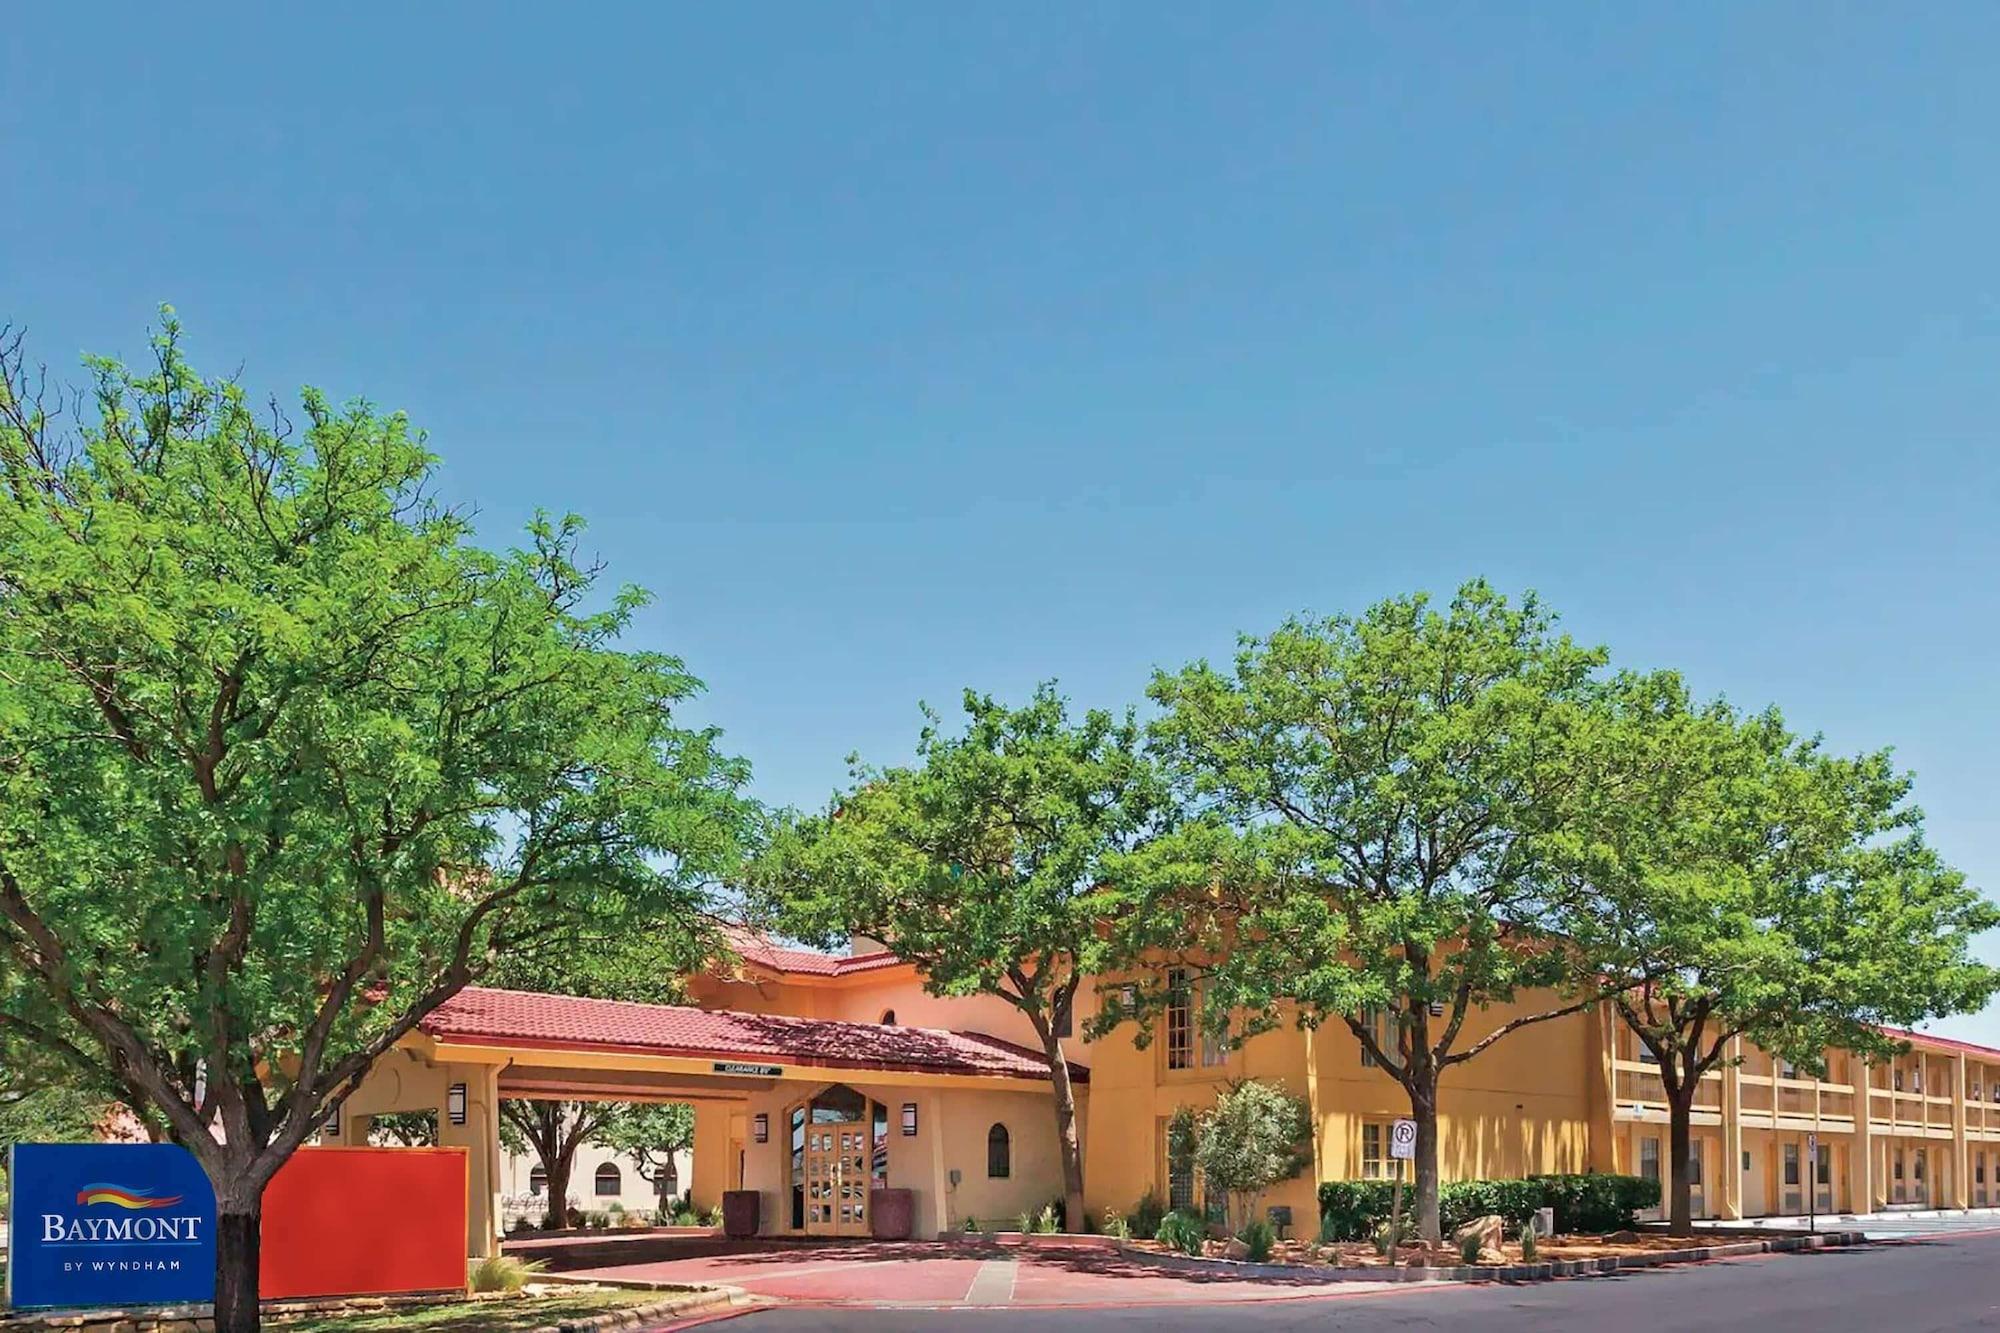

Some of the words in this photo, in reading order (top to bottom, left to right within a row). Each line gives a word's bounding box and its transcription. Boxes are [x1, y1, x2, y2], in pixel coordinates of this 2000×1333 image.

[41, 1214, 202, 1242] BAYMONT
[64, 1262, 84, 1271] BY
[92, 1261, 180, 1271] WYNDHAM
